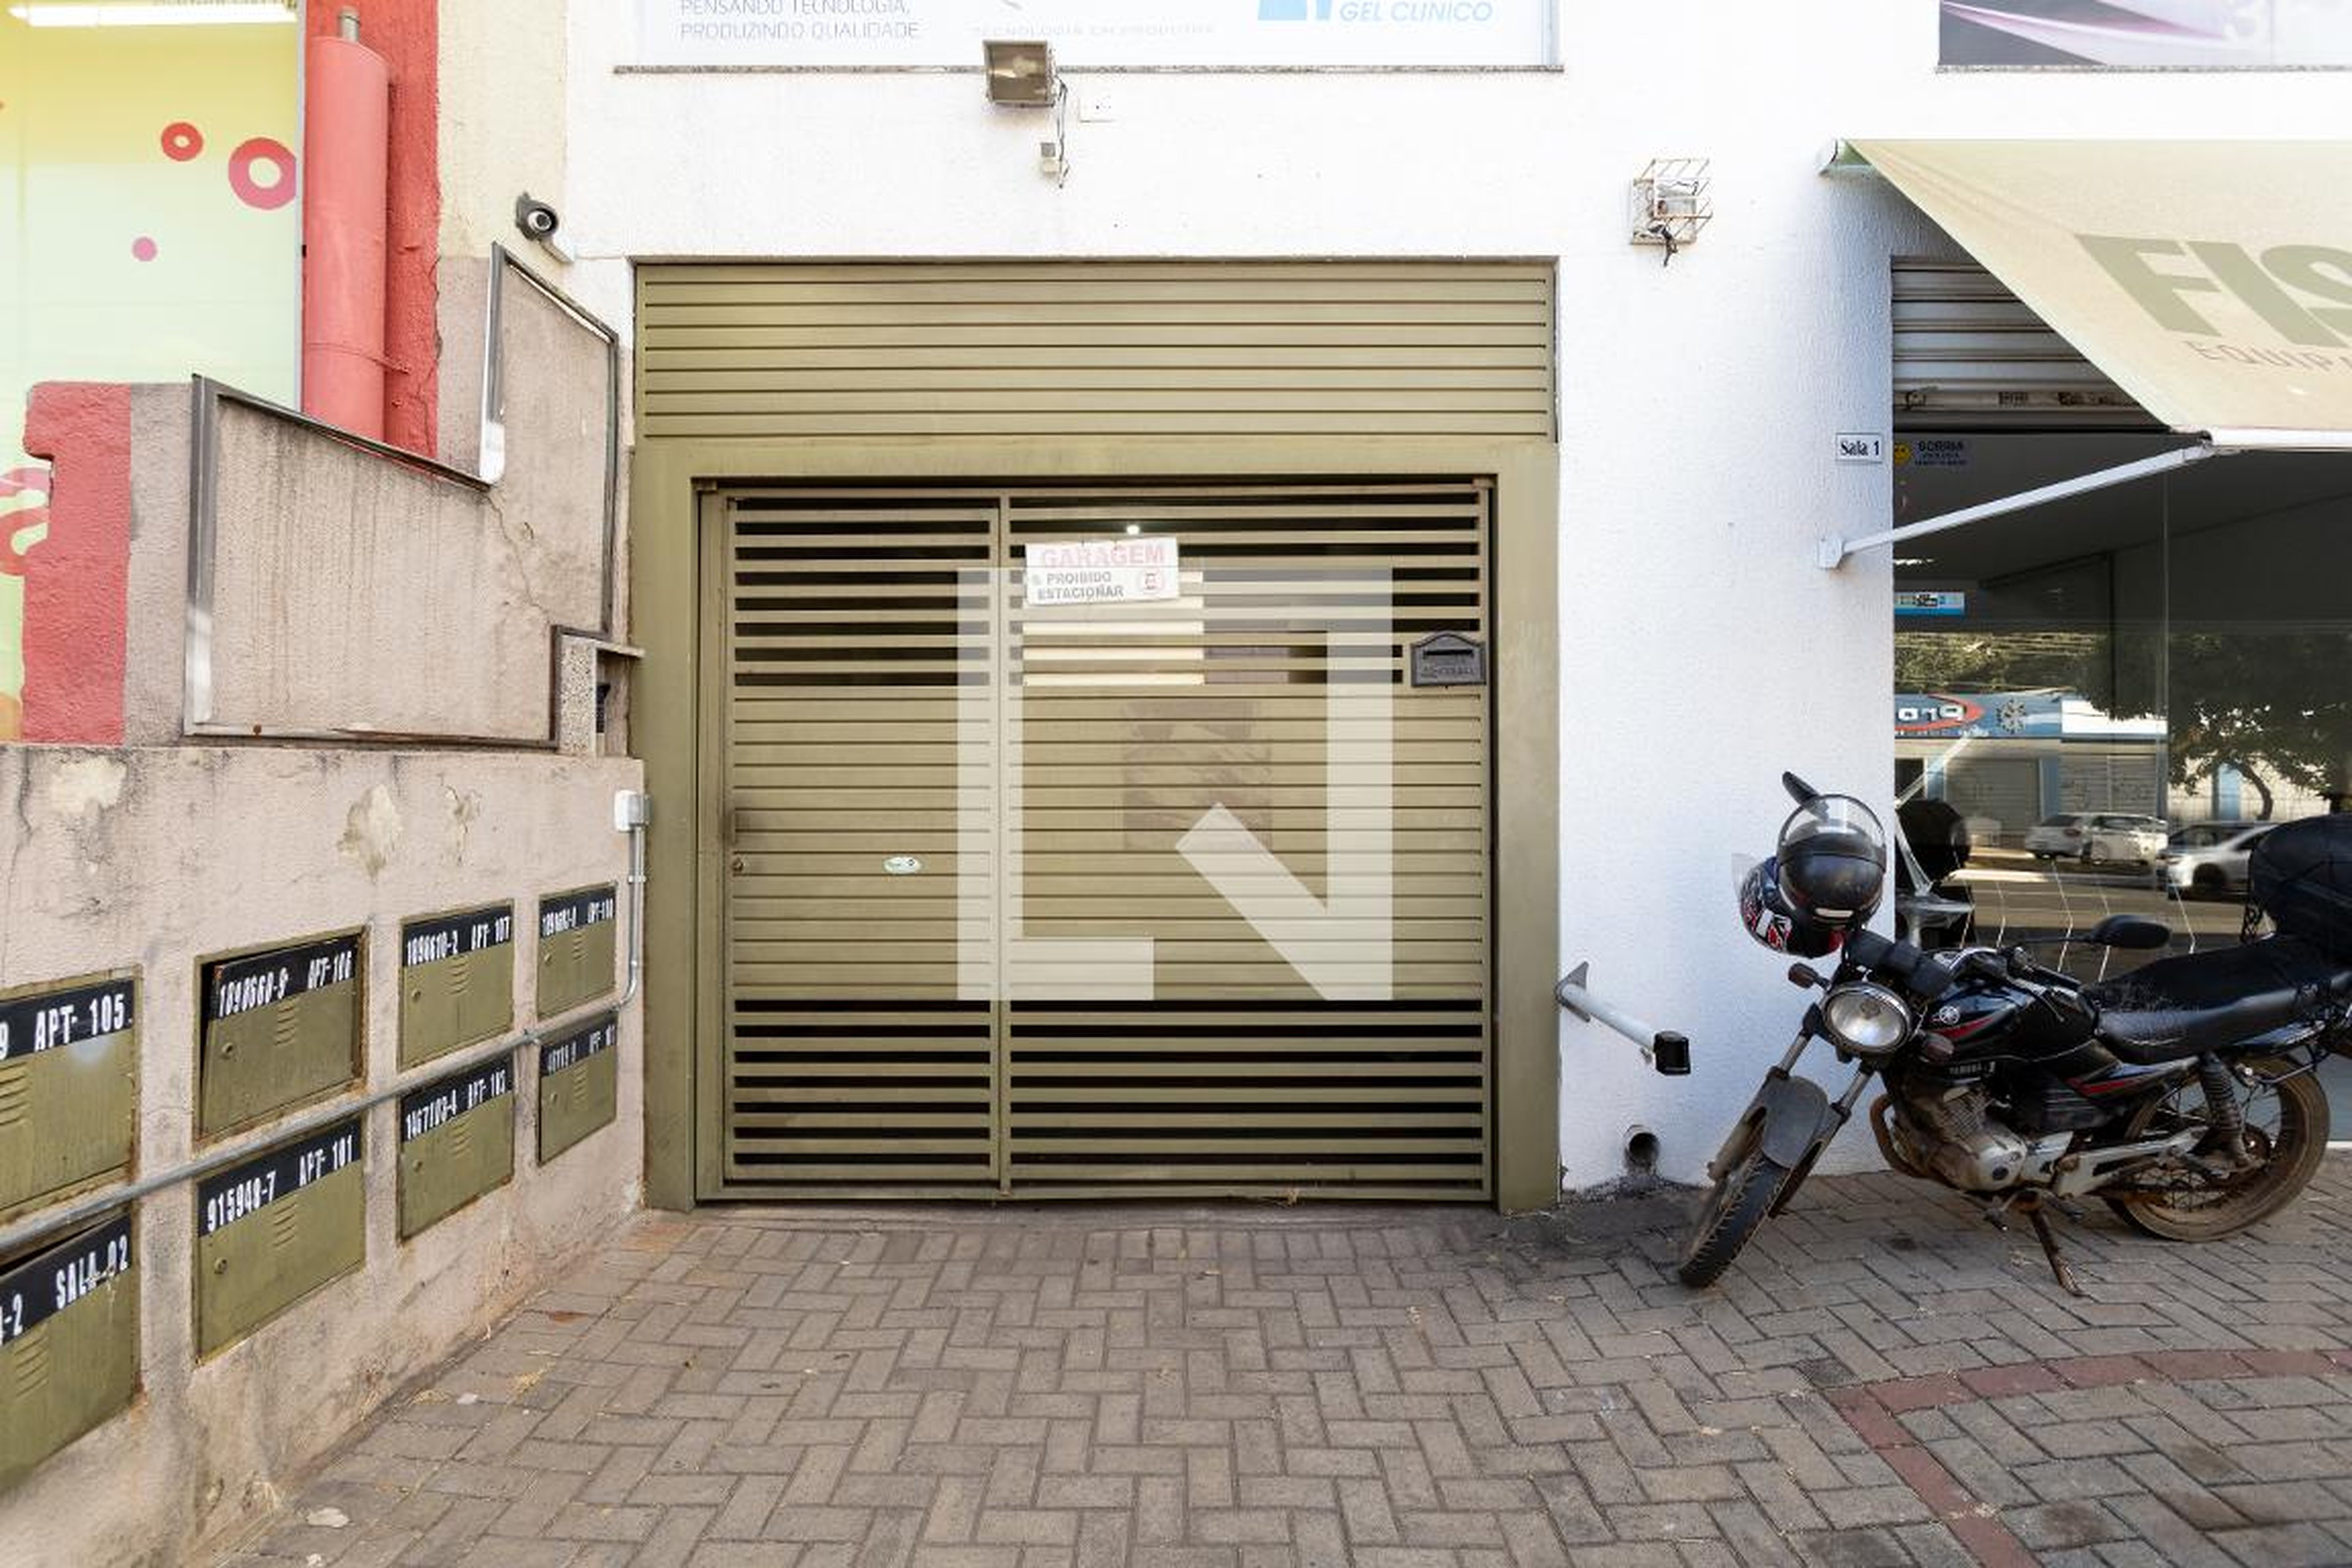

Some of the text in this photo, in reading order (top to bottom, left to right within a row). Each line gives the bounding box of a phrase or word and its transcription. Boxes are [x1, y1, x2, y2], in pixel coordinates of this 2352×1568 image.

[1340, 1, 1381, 21] GEL
[680, 21, 920, 40] PRODUZINDO QUALIDADE
[1873, 439, 1880, 456] 1
[1042, 543, 1164, 566] GARAGEM
[1047, 571, 1112, 584] PROIBIDO
[1038, 585, 1124, 600] ESTACIONAR
